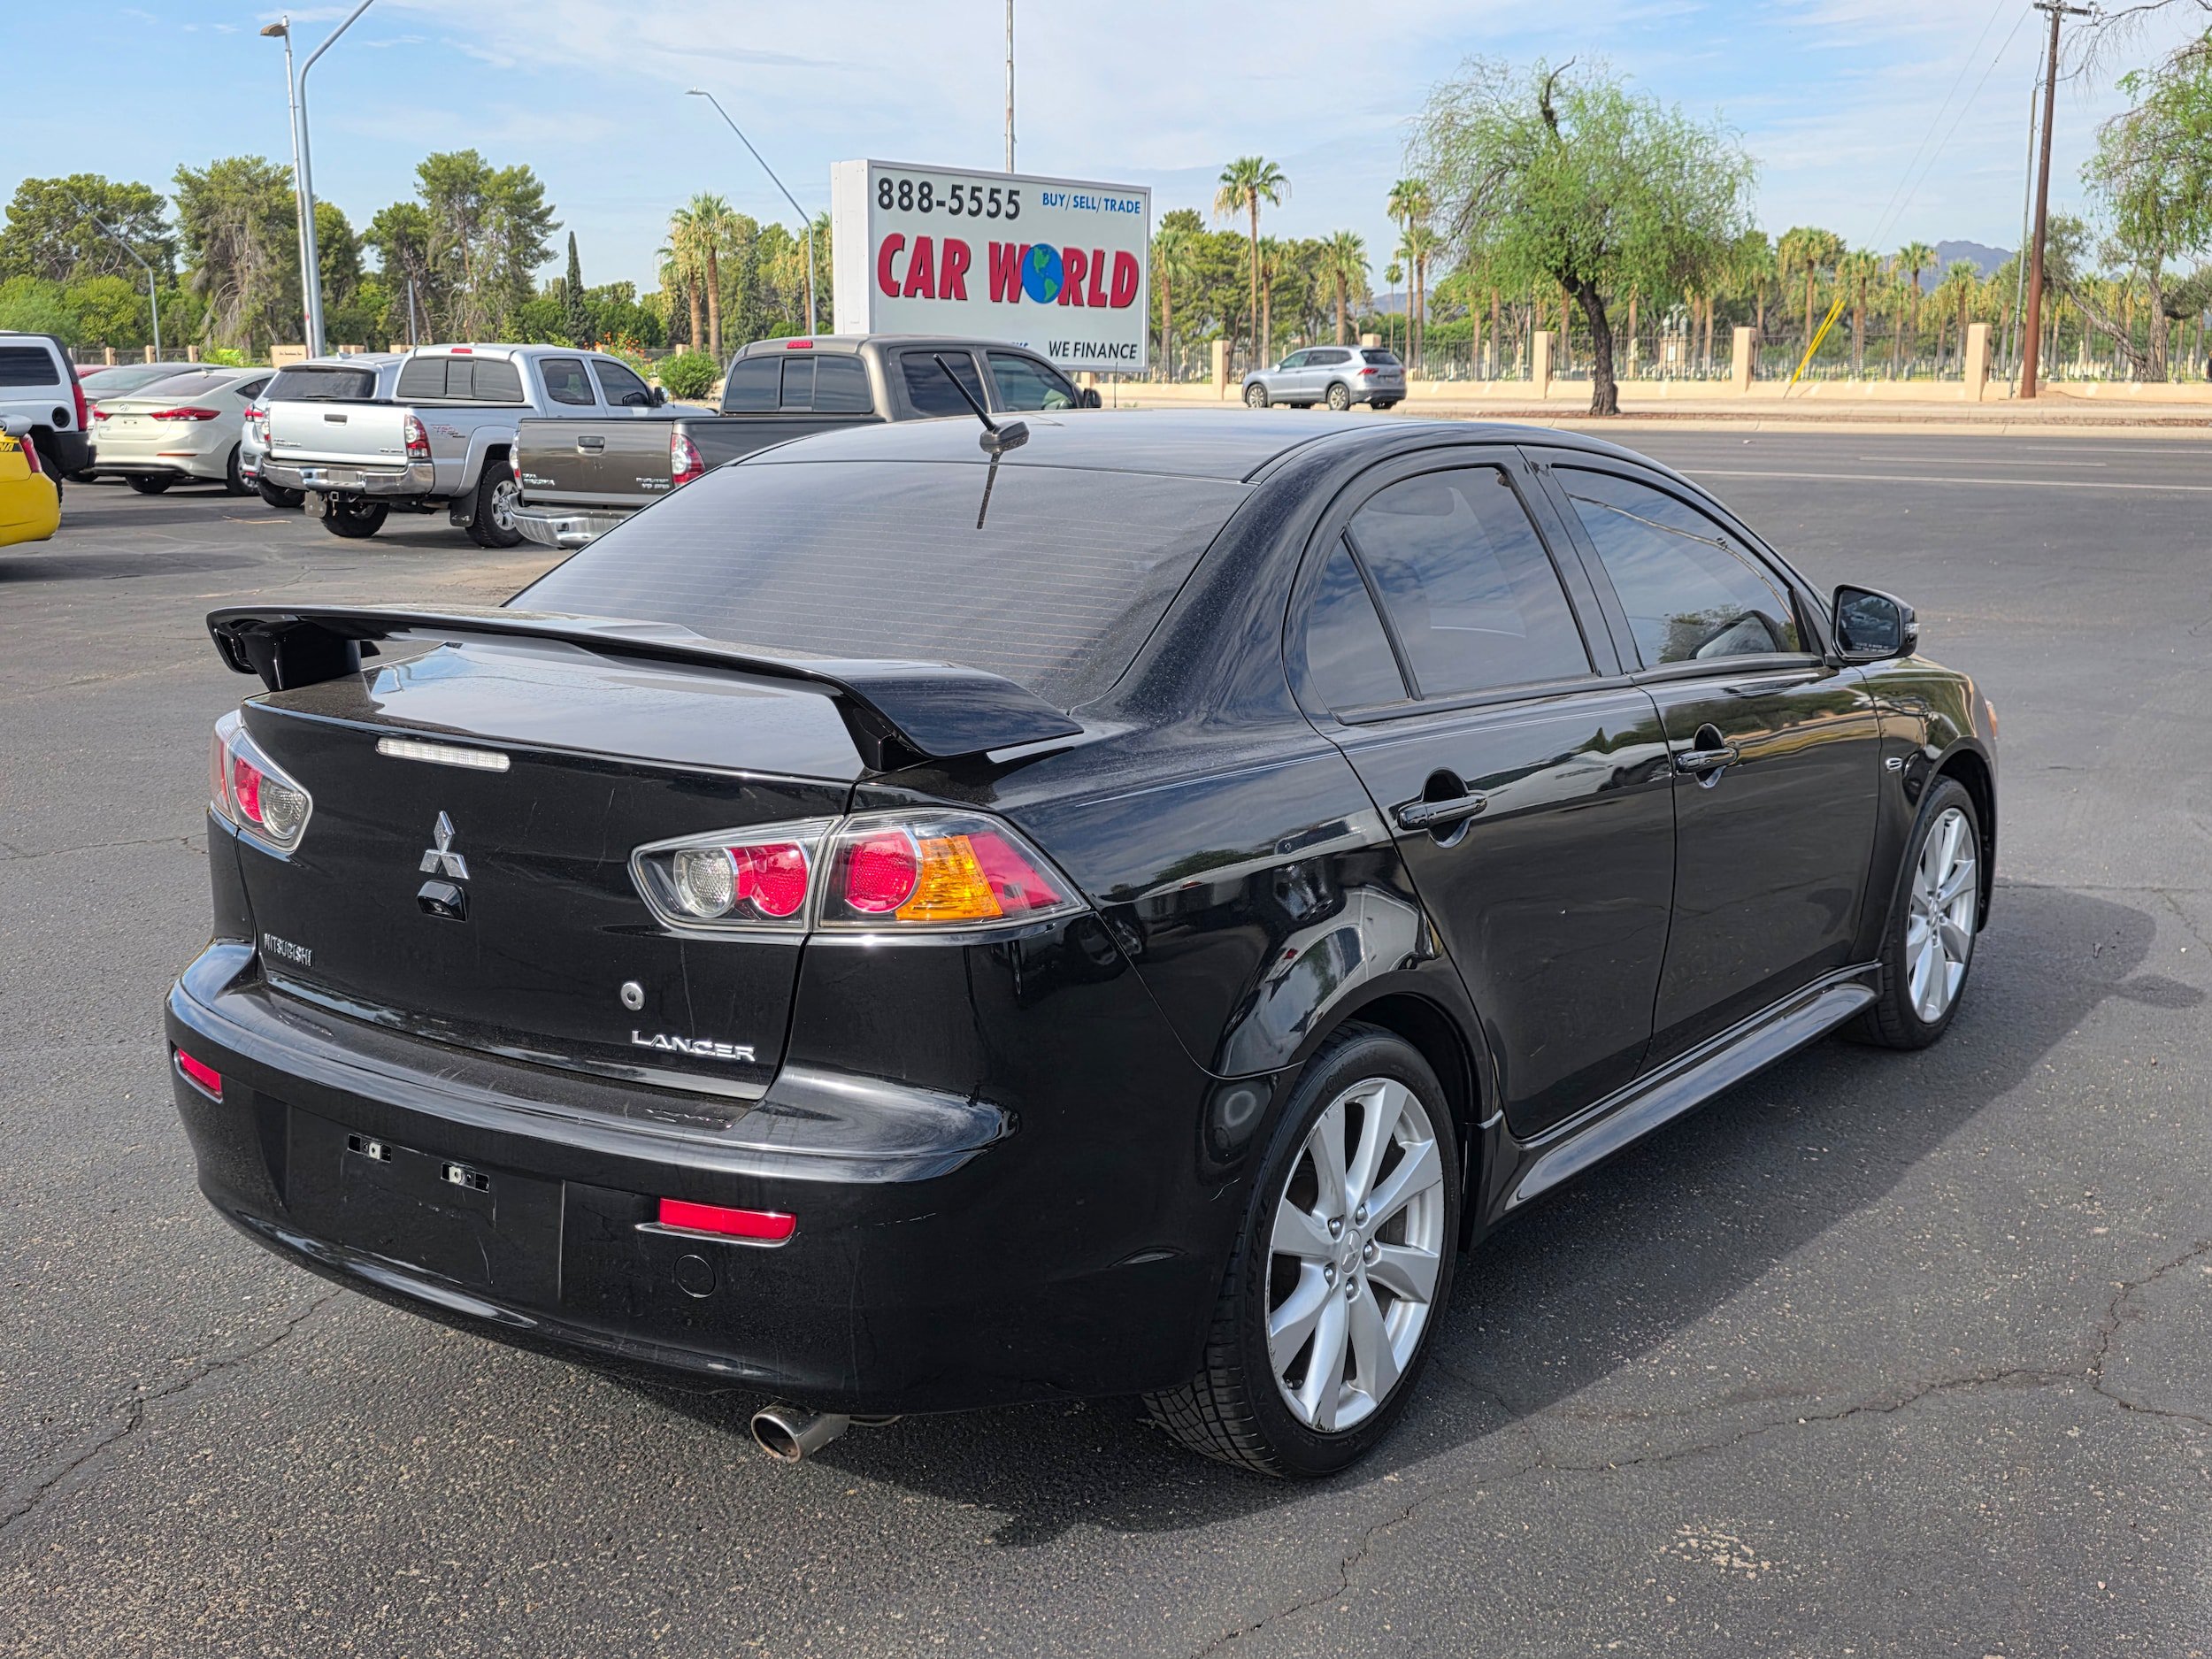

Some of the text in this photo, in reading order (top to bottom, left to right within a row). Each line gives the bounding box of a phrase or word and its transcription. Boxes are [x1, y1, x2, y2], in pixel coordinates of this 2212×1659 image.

[878, 177, 1021, 220] 888-5555
[1104, 197, 1141, 214] TRADE
[878, 233, 971, 301] CAR
[1049, 340, 1138, 359] WE FINANCE
[265, 933, 312, 967] MITSUBISHI
[632, 1030, 756, 1062] LANCER
